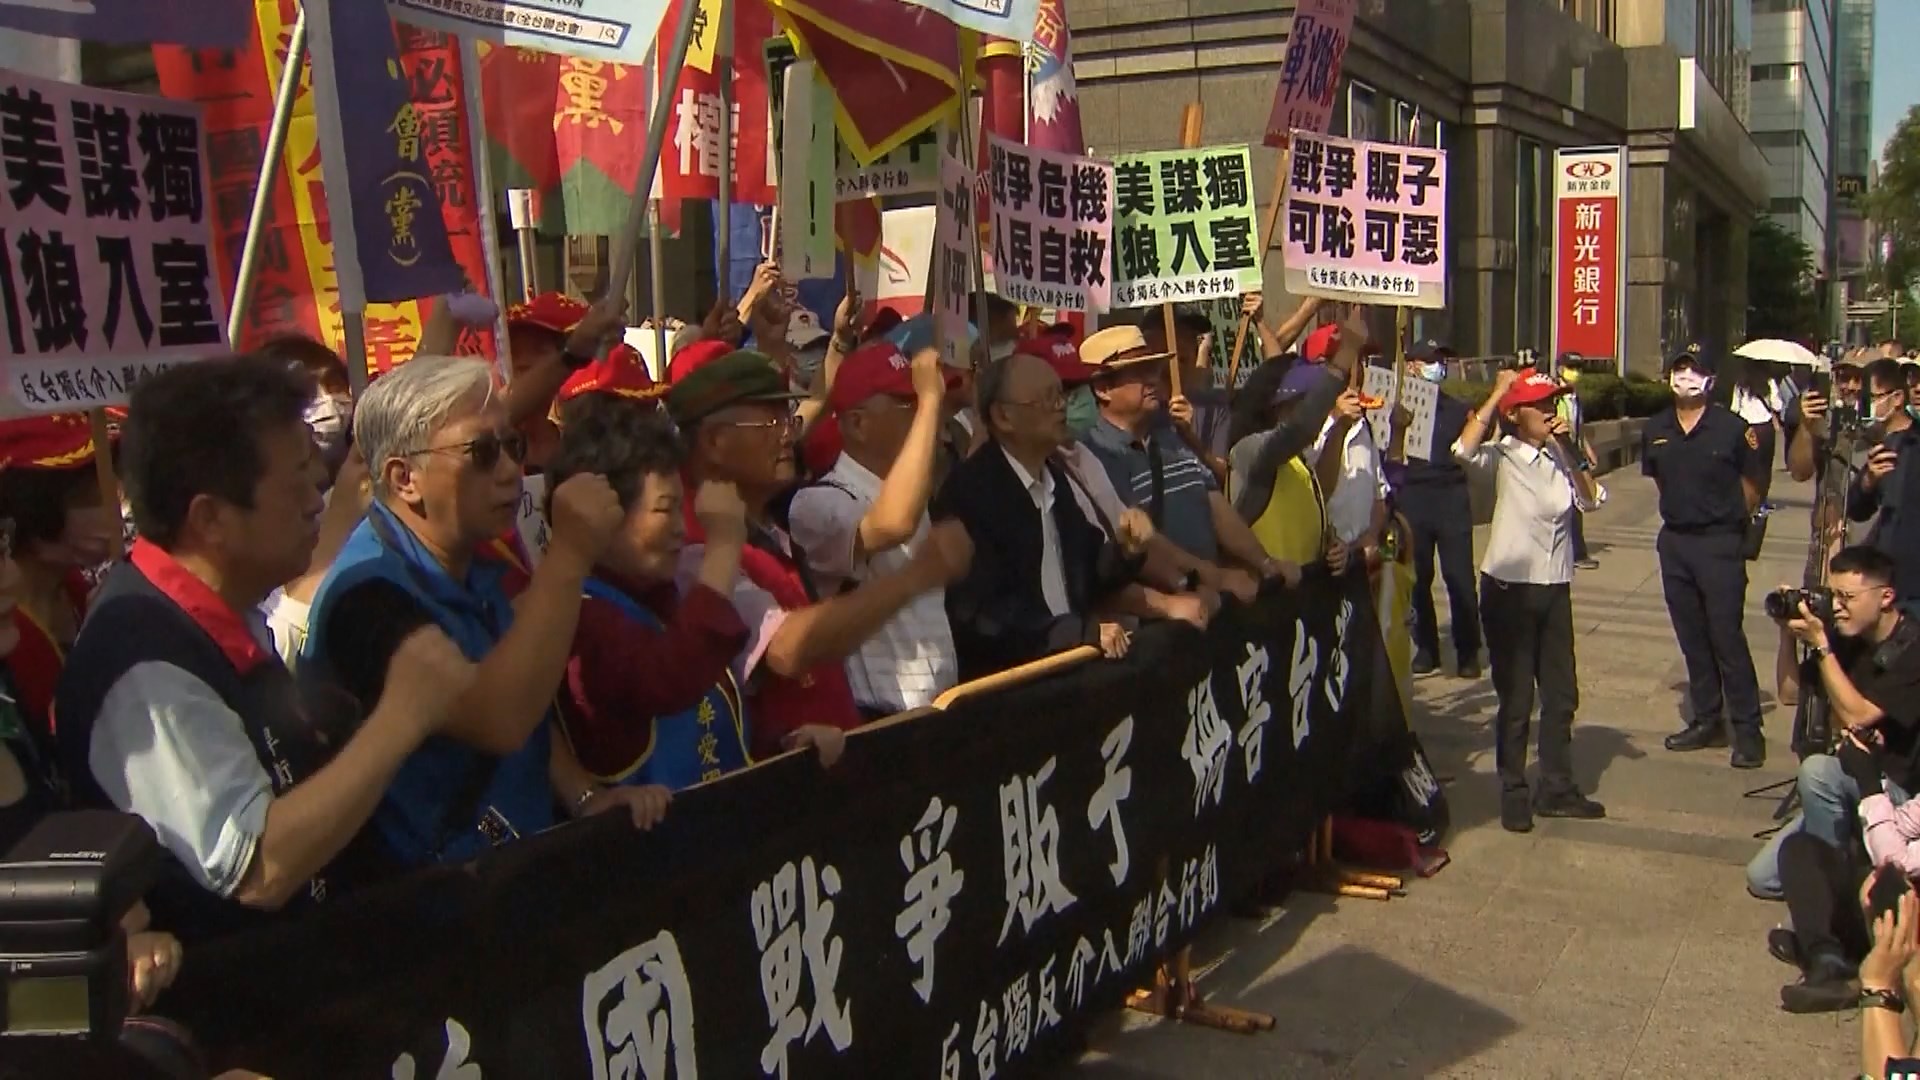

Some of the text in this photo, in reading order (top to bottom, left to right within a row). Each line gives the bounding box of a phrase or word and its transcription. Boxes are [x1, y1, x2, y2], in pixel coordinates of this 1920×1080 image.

[0, 85, 203, 223] 美謀獨
[674, 88, 741, 183] 權
[1291, 138, 1440, 206] 戰爭販子
[991, 144, 1108, 224] 戰爭危機
[1115, 153, 1248, 218] 美謀獨
[1567, 179, 1611, 193] 新光金控
[994, 211, 1107, 288] 人民自救
[1289, 199, 1439, 265] 可恥可惡
[1572, 202, 1602, 326] 新光銀行
[0, 227, 222, 354] 狼入室
[1116, 276, 1234, 303] 反台獨反介入聯合行動
[1310, 267, 1415, 293] 反台獨反介入聯合行動
[20, 363, 169, 403] 反台獨反介入聯
[391, 715, 1136, 1080] 國戰爭販子
[939, 843, 1219, 1080] 反台獨反介入聯合行動
